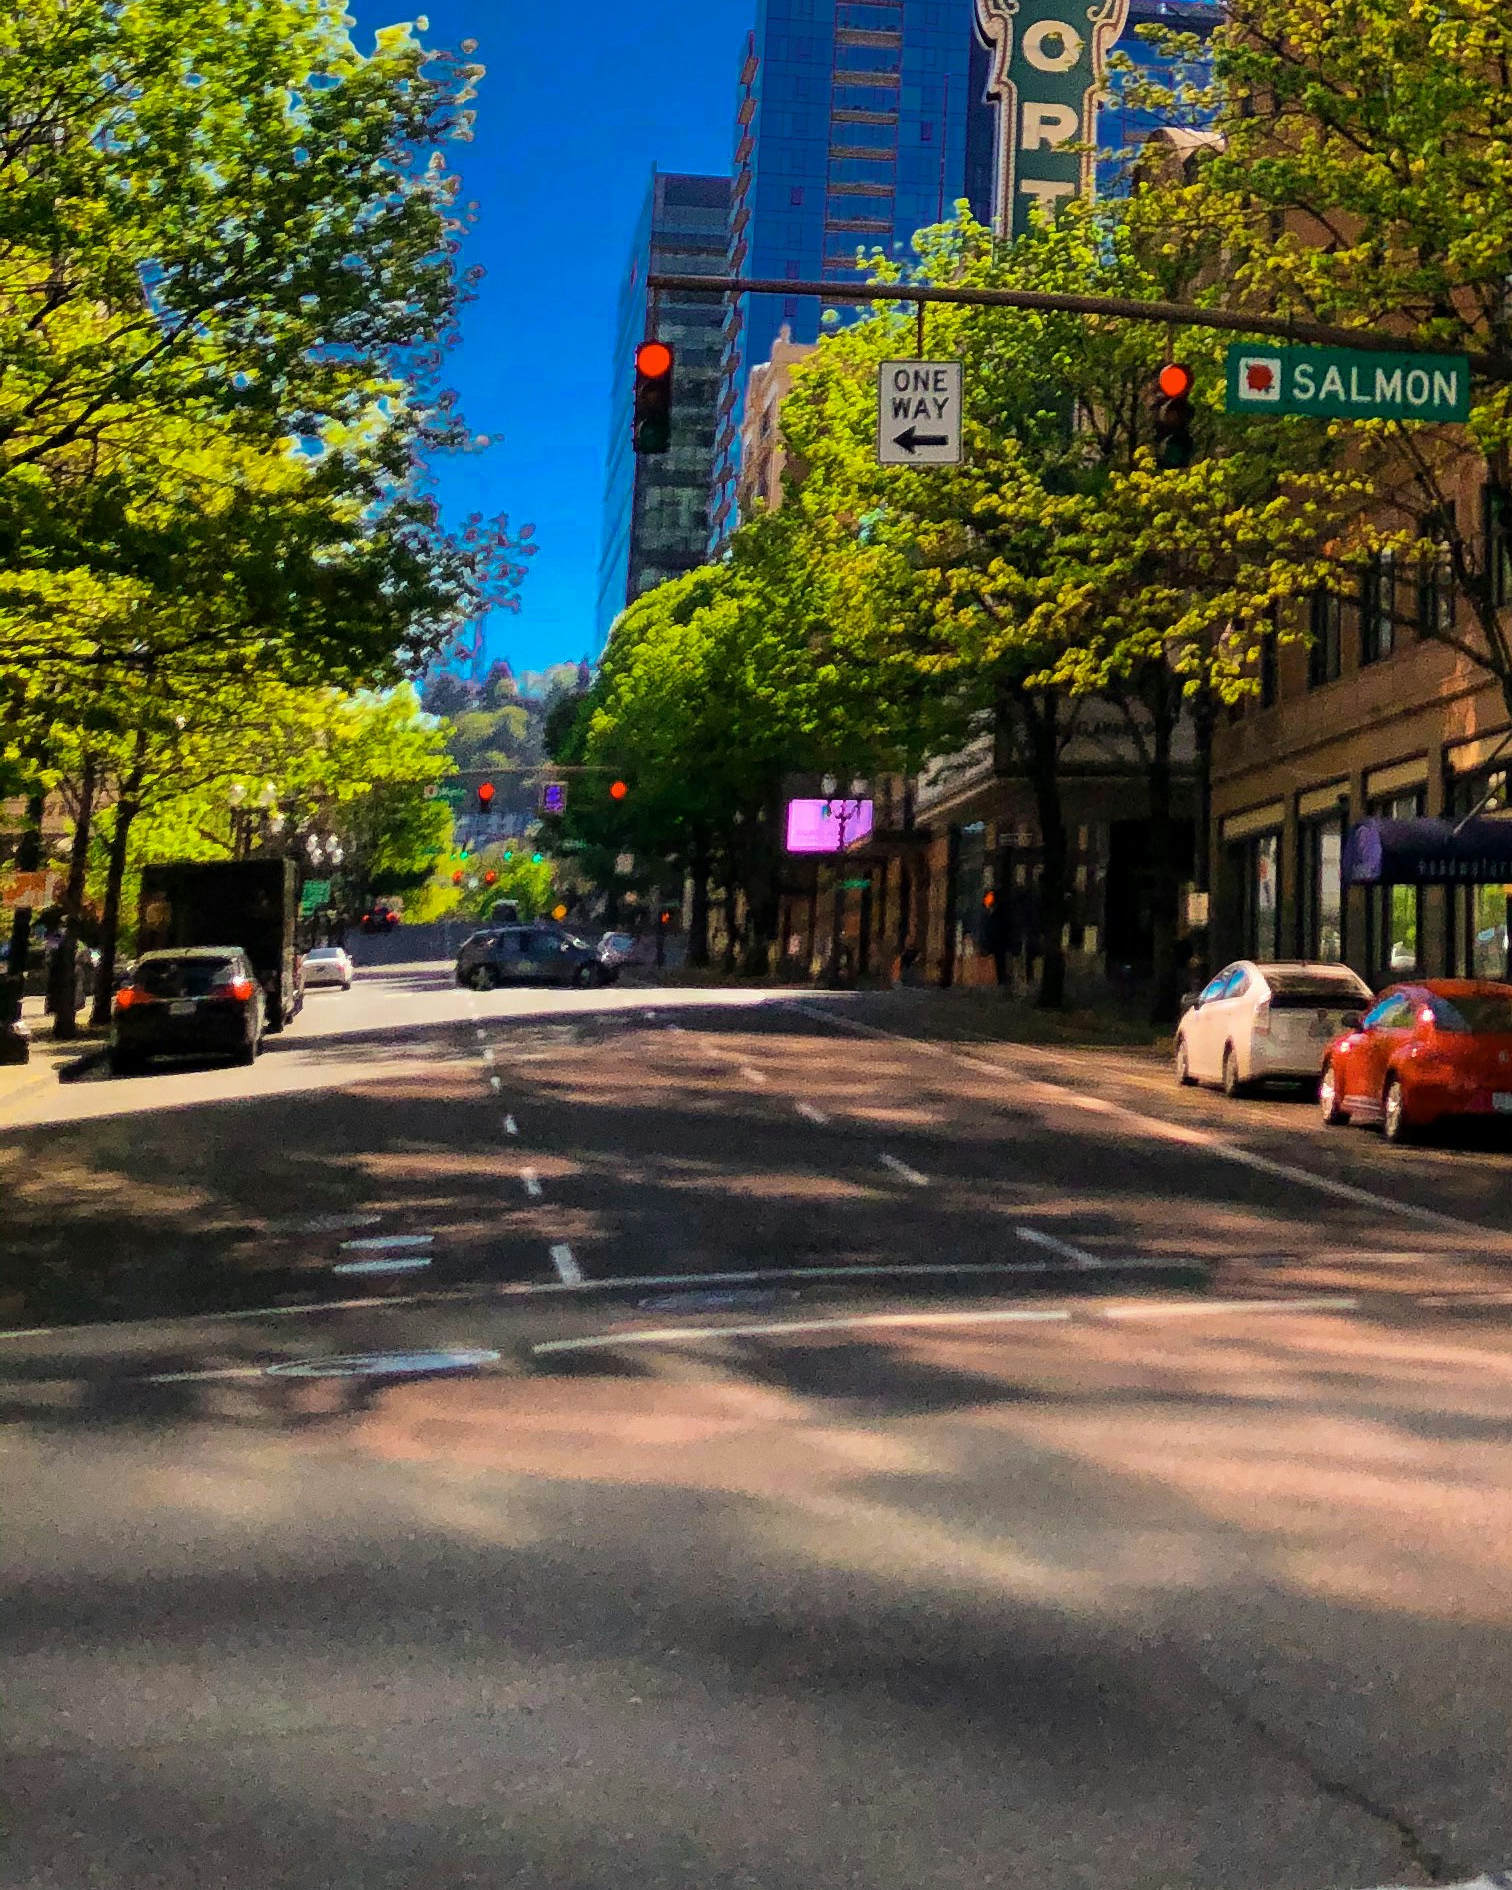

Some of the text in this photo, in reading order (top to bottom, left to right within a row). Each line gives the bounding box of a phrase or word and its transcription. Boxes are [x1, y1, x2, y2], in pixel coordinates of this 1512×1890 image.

[894, 369, 948, 393] ONE
[1292, 362, 1458, 408] SALMON
[891, 396, 949, 420] WAY
